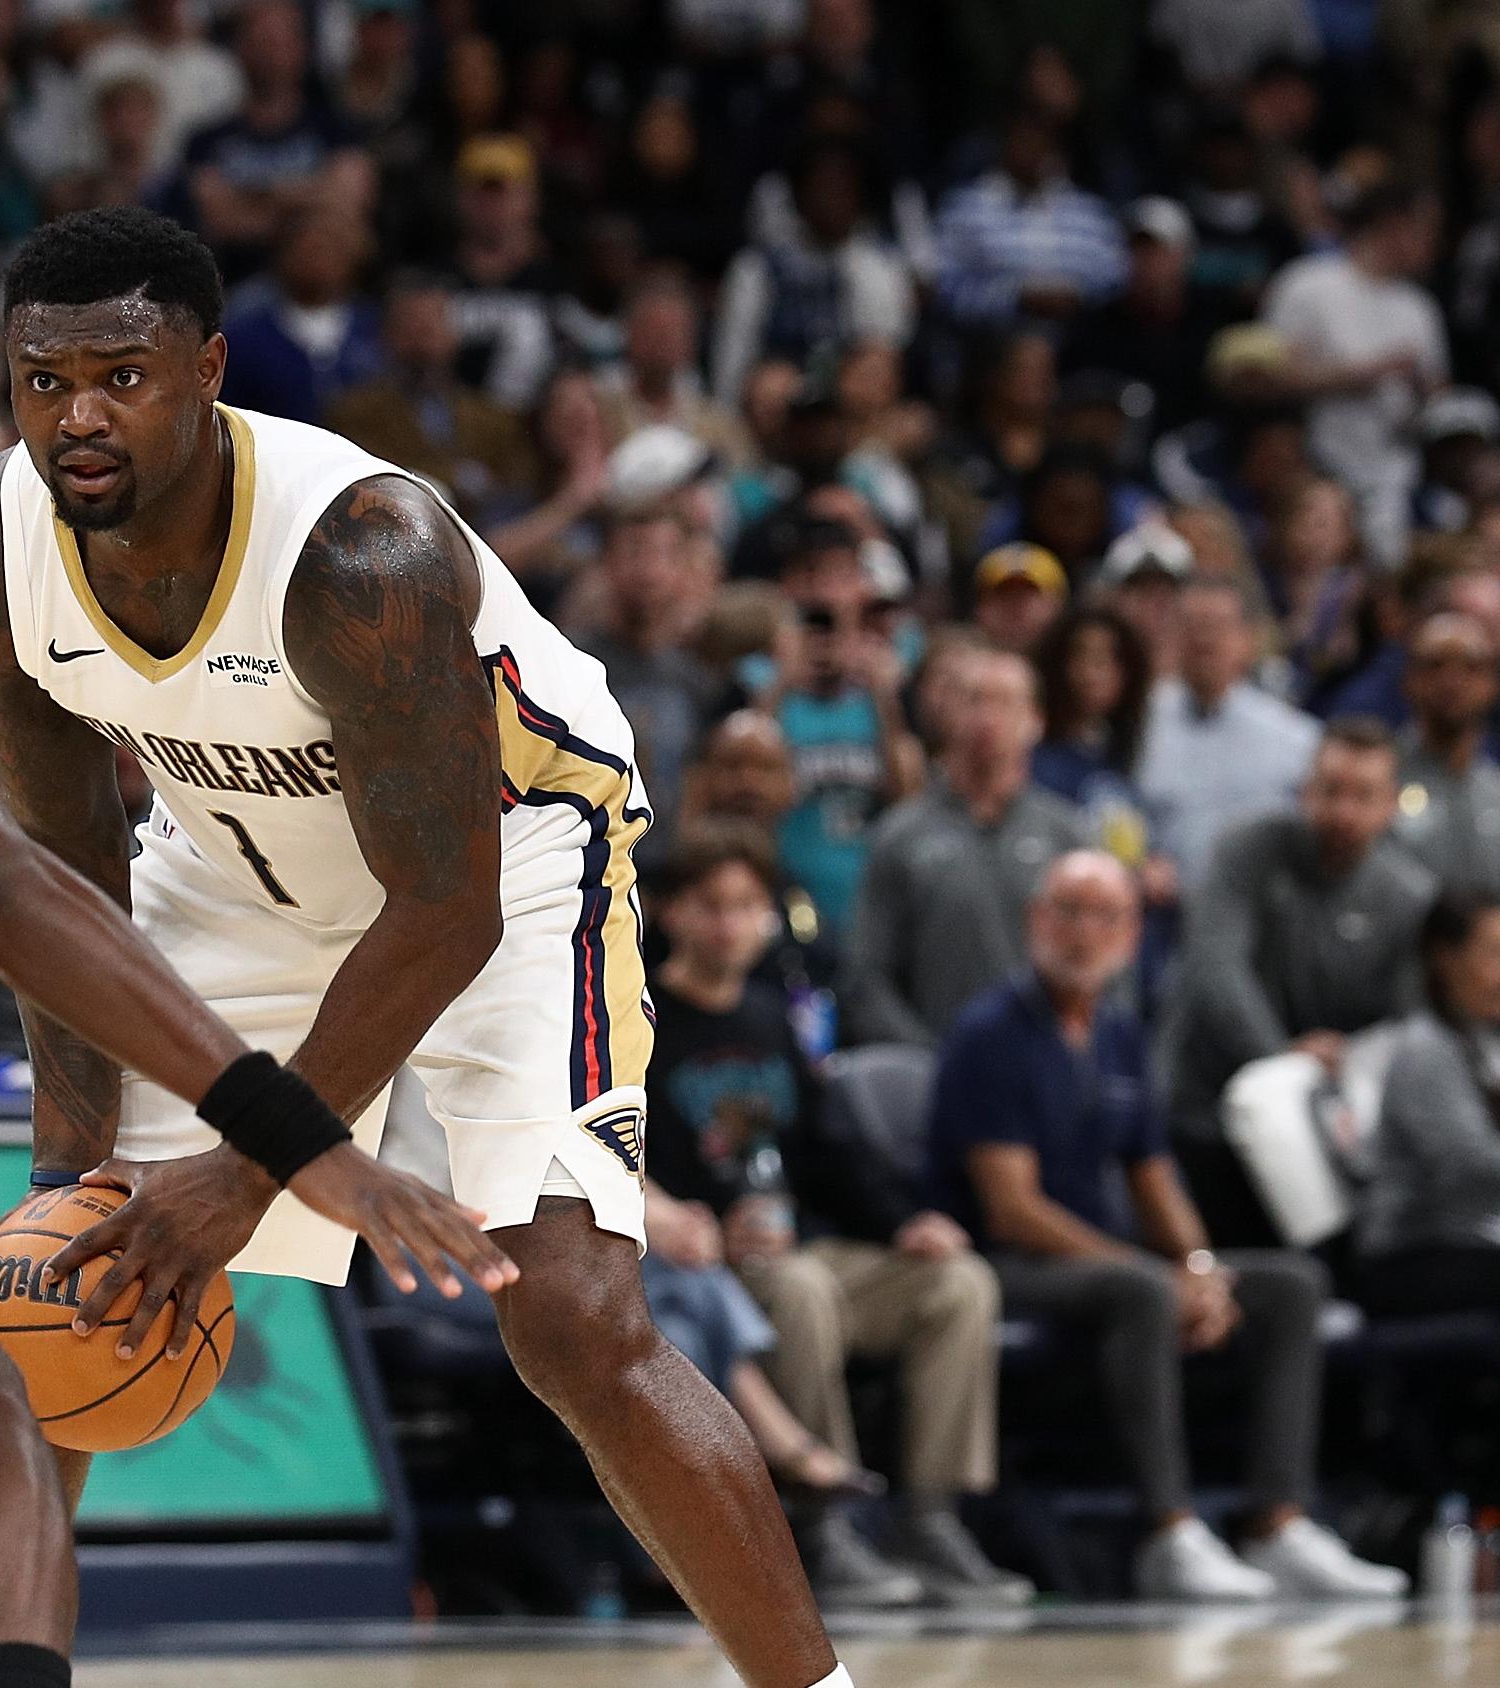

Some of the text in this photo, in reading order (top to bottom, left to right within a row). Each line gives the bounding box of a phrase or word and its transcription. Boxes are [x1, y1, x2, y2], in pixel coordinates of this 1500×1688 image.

[232, 673, 268, 686] GRILLS
[141, 731, 341, 798] ORLEANS
[205, 808, 301, 909] 1
